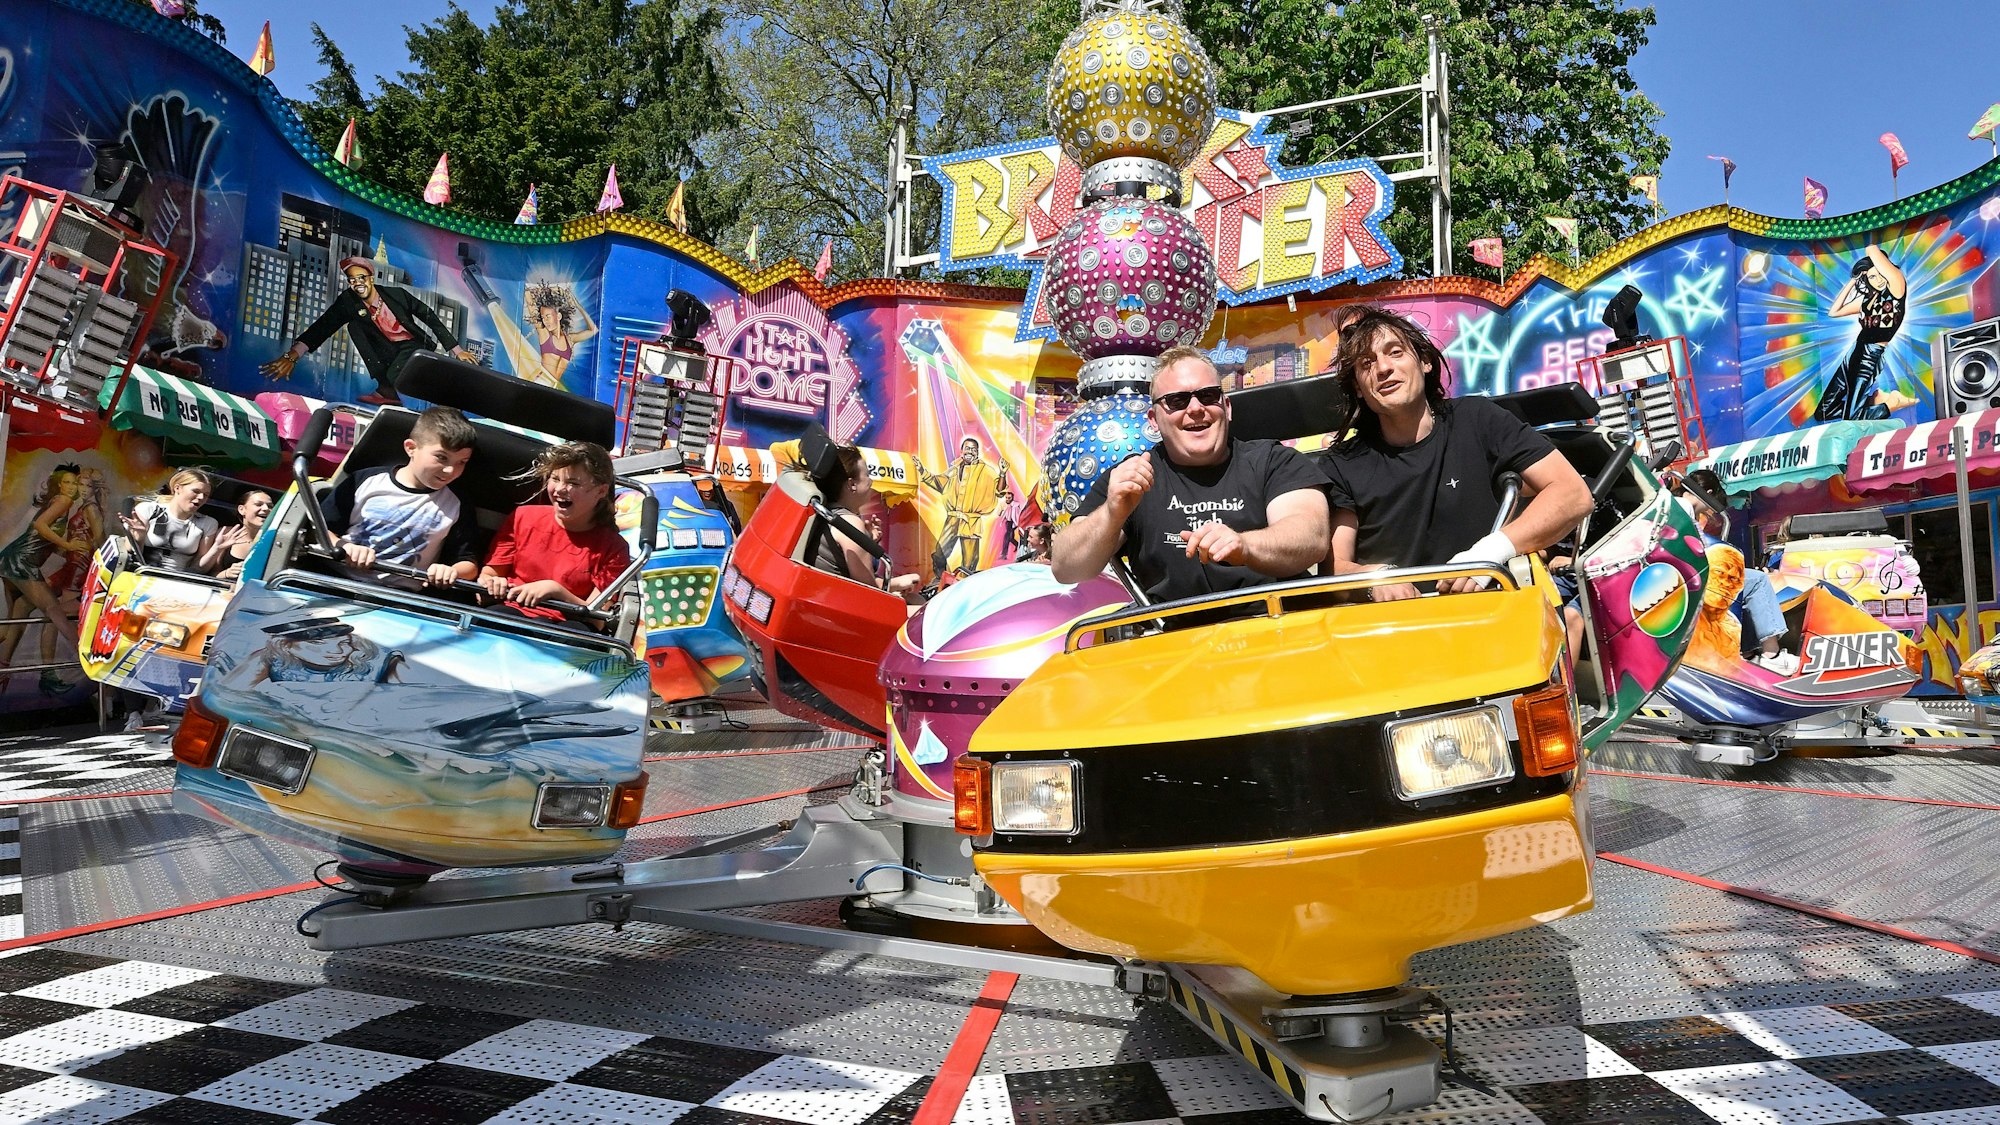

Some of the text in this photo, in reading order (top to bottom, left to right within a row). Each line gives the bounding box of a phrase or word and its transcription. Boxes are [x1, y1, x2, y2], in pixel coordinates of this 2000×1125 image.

[745, 335, 823, 373] LIGHT
[731, 359, 846, 406] DOME
[149, 391, 262, 441] NO RISK NO FUN
[716, 461, 770, 478] KRASS !!!
[1741, 445, 1810, 476] GENERATION
[1802, 632, 1905, 673] SILVER
